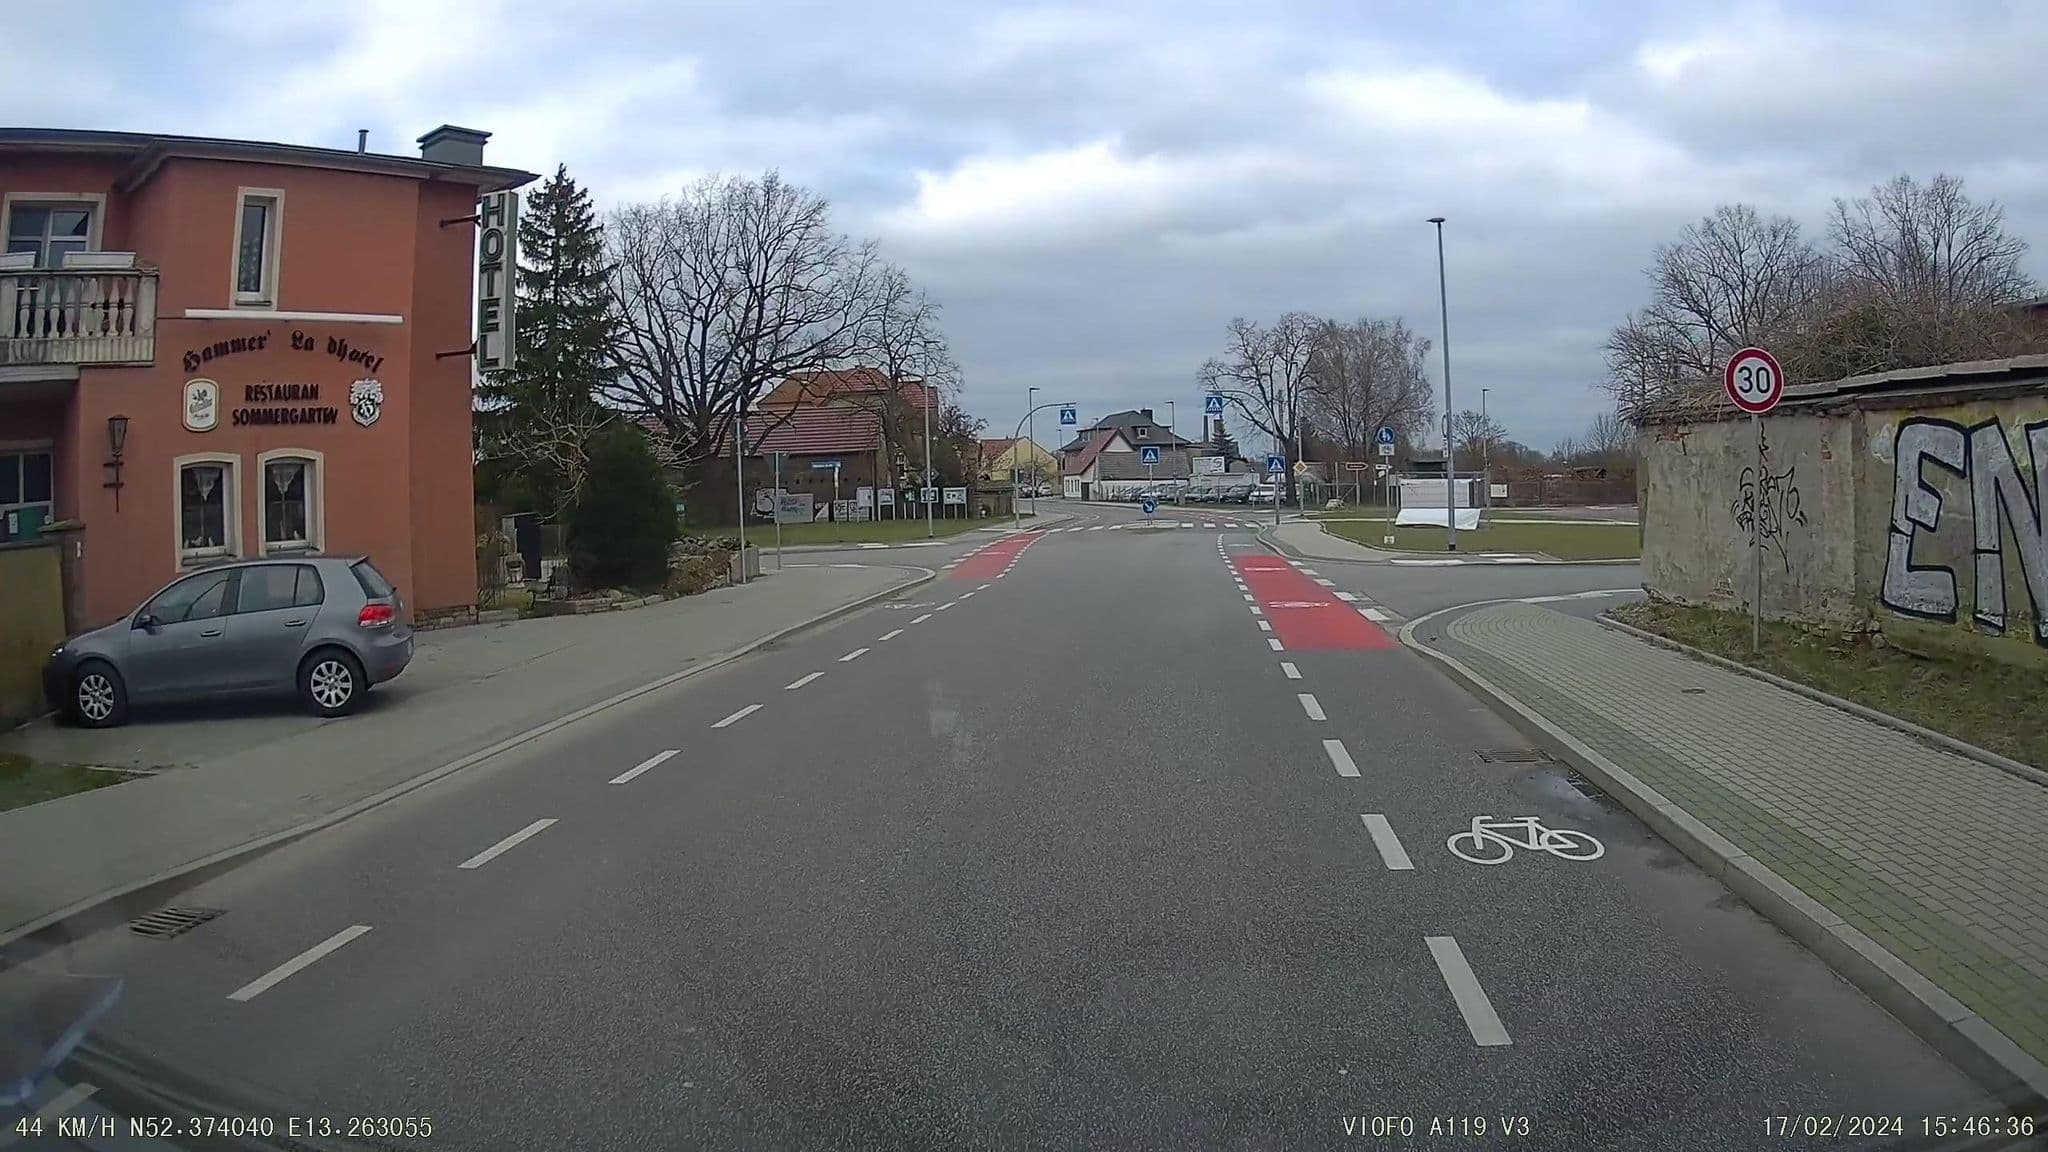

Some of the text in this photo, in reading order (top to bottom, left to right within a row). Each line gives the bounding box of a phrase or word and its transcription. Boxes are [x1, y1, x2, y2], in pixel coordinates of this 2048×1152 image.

[480, 193, 505, 368] HOTEL
[245, 383, 319, 401] RESTAURAN
[1738, 366, 1770, 393] 30
